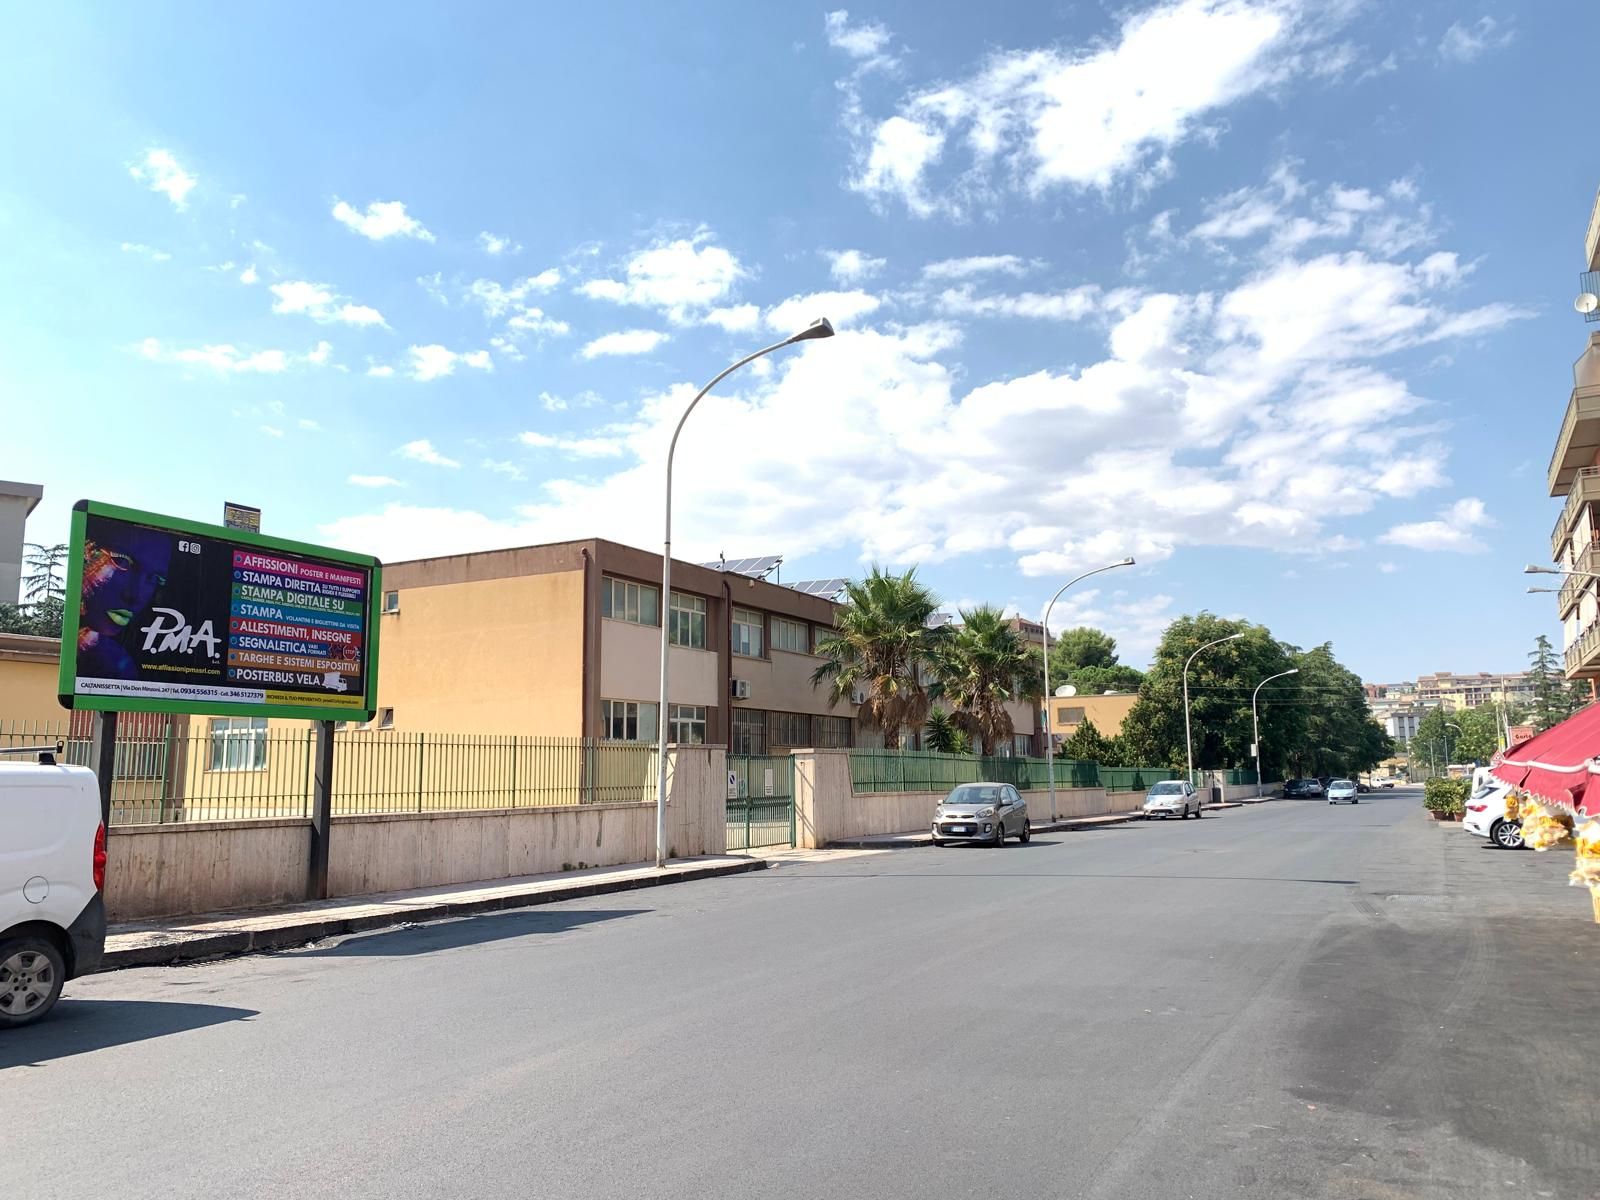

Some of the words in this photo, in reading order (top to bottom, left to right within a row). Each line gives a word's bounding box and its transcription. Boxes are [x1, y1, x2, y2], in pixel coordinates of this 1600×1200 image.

[244, 556, 298, 574] AFFISSIONI
[300, 568, 324, 580] POSTER
[325, 572, 329, 580] E
[330, 573, 361, 584] MANIFESTI
[242, 571, 282, 588] STAMPA
[285, 578, 321, 593] DIRETTA
[242, 585, 284, 602] STAMPA
[286, 592, 330, 610] DIGITALE
[332, 600, 344, 610] SU
[240, 604, 283, 619] STAMPA
[286, 615, 310, 624] VOLANTINI
[240, 620, 310, 640] ALLESTIMENTI,
[312, 630, 352, 643] INSEGNE
[239, 636, 306, 654] SEGNALETICA
[239, 652, 274, 664] TARGHE
[276, 656, 281, 665] E
[284, 657, 314, 668] SISTEMI
[317, 660, 359, 672] ESPOSITIVI
[236, 669, 294, 683] POSTERBUS
[296, 674, 320, 686] VELA
